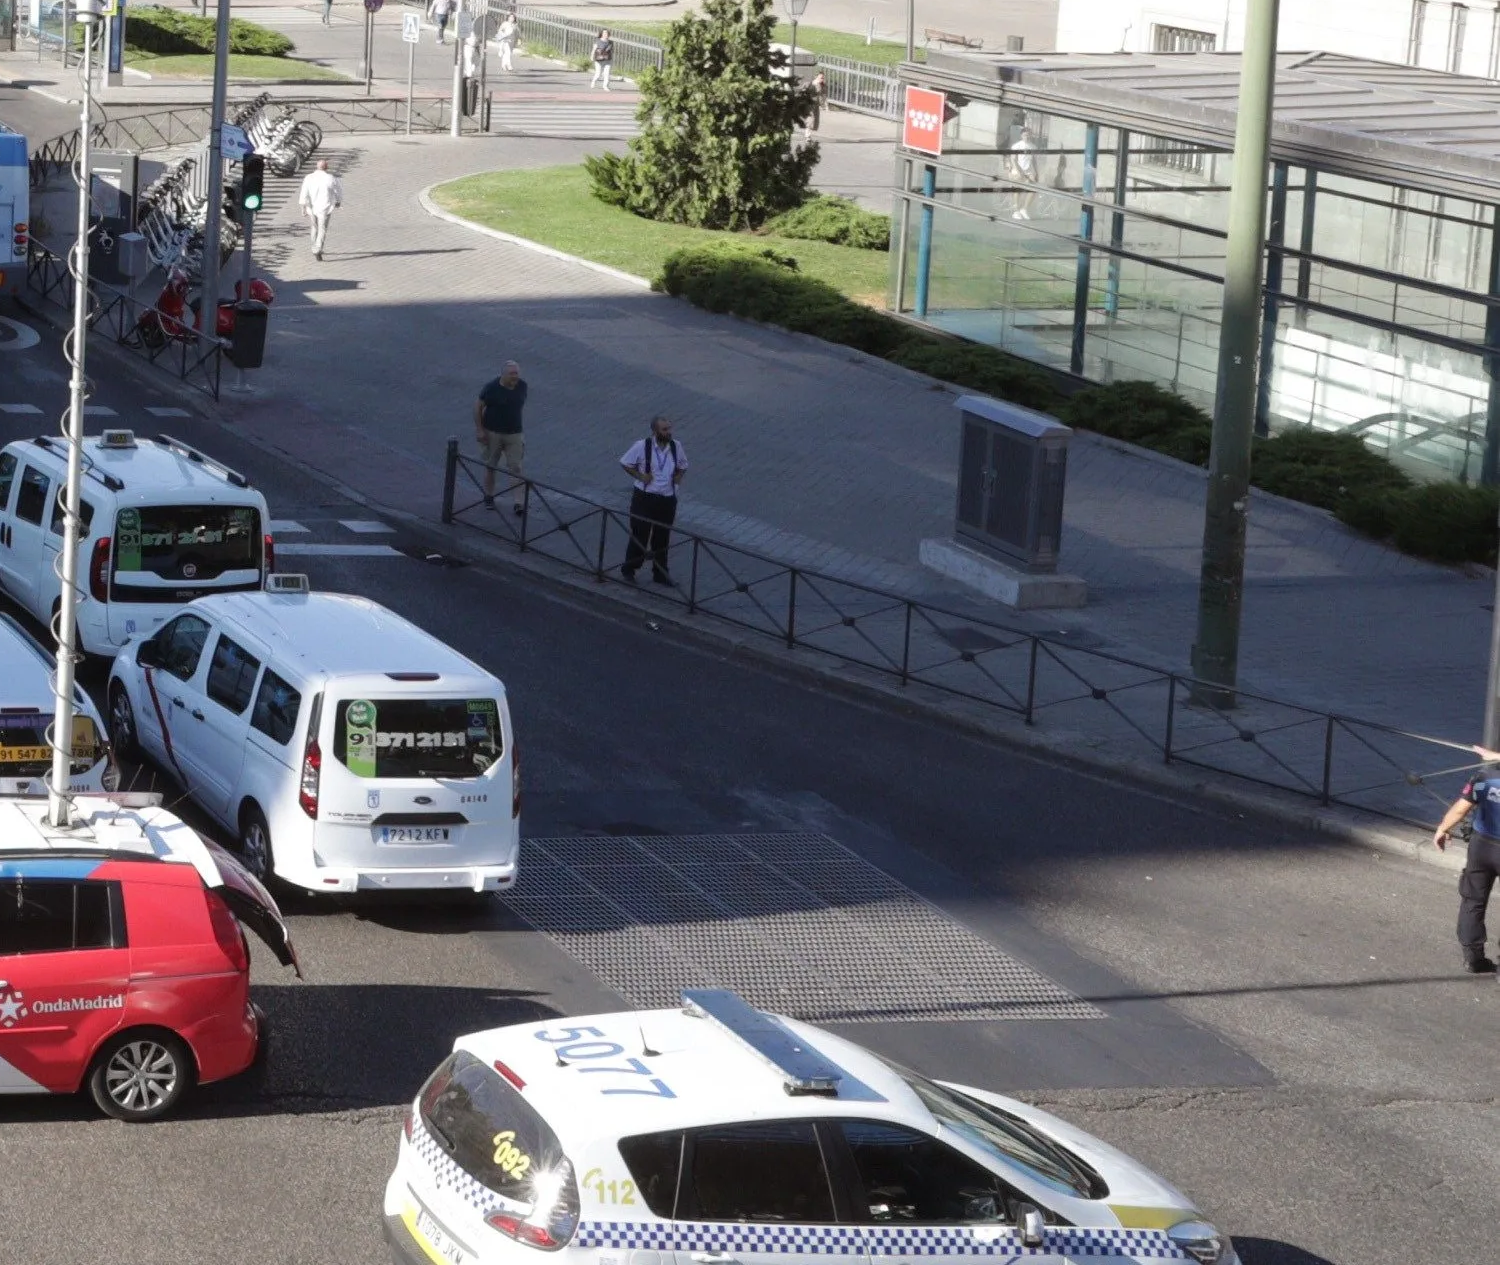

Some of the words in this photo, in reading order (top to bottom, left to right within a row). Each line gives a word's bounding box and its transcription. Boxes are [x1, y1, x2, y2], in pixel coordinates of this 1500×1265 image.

[350, 733, 373, 745] 91
[0, 750, 12, 760] 91
[18, 749, 37, 760] 547
[391, 829, 422, 840] 7212
[426, 828, 449, 840] KFW
[32, 994, 123, 1014] OndaMadrid
[533, 1026, 677, 1098] 5077
[493, 1141, 531, 1180] 092
[595, 1179, 635, 1205] 112
